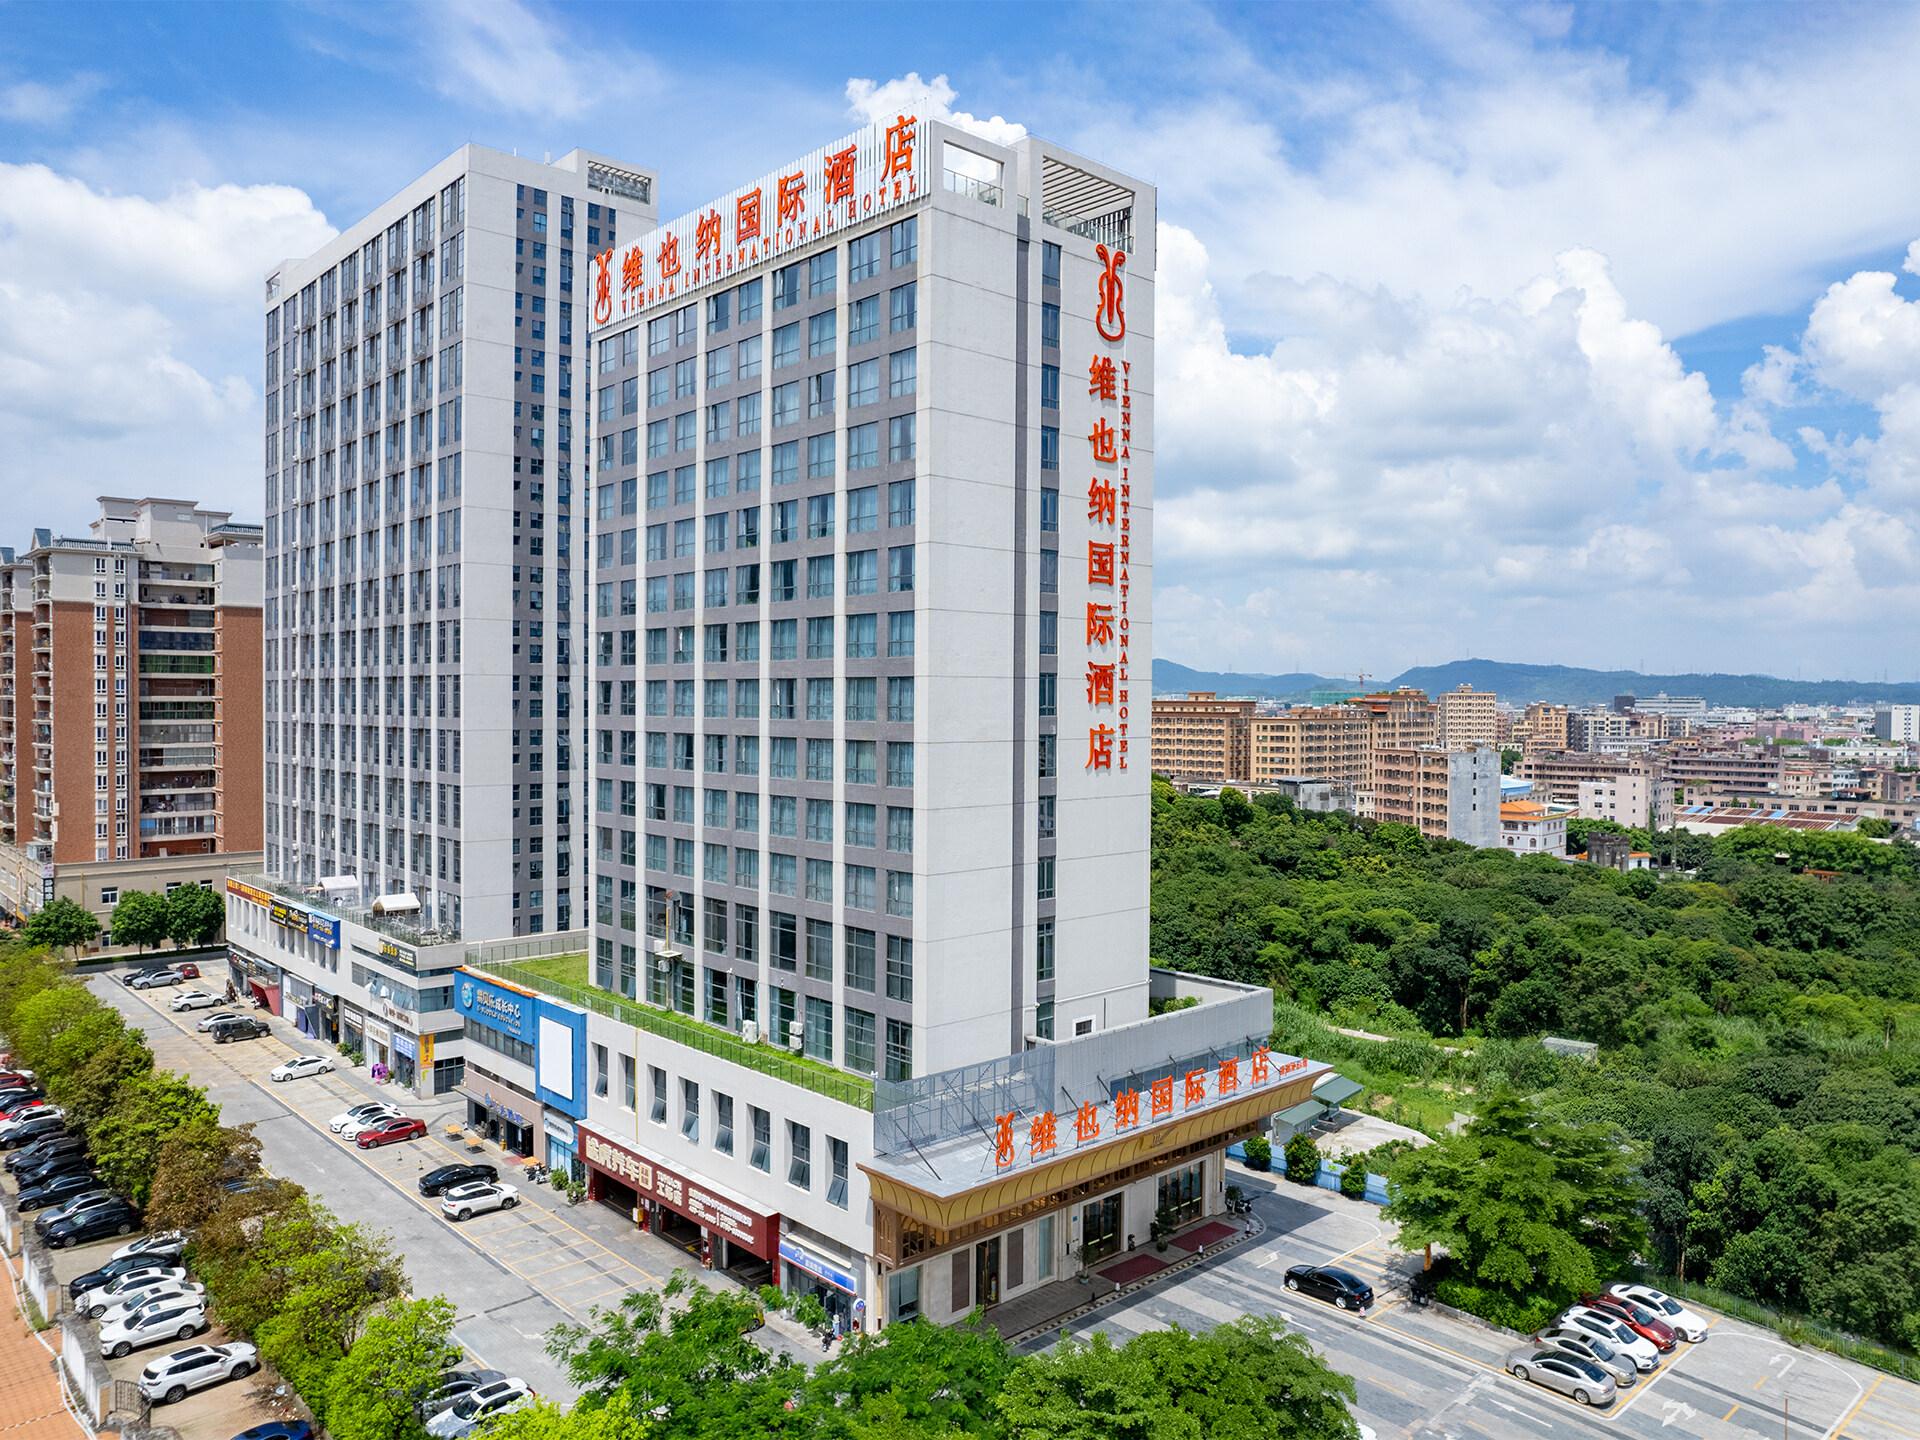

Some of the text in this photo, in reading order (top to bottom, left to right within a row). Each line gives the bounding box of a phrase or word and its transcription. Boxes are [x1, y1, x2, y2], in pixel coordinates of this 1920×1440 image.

[621, 114, 918, 294] 维也纳国际酒店
[621, 174, 918, 314] VIENNA INTERNATIONAL HOTEL
[1085, 354, 1118, 769] 维也纳国际酒店
[1118, 360, 1131, 769] VIENNA INTERNATIONAL HOTEL
[1030, 1046, 1271, 1157] 维也纳国际酒店
